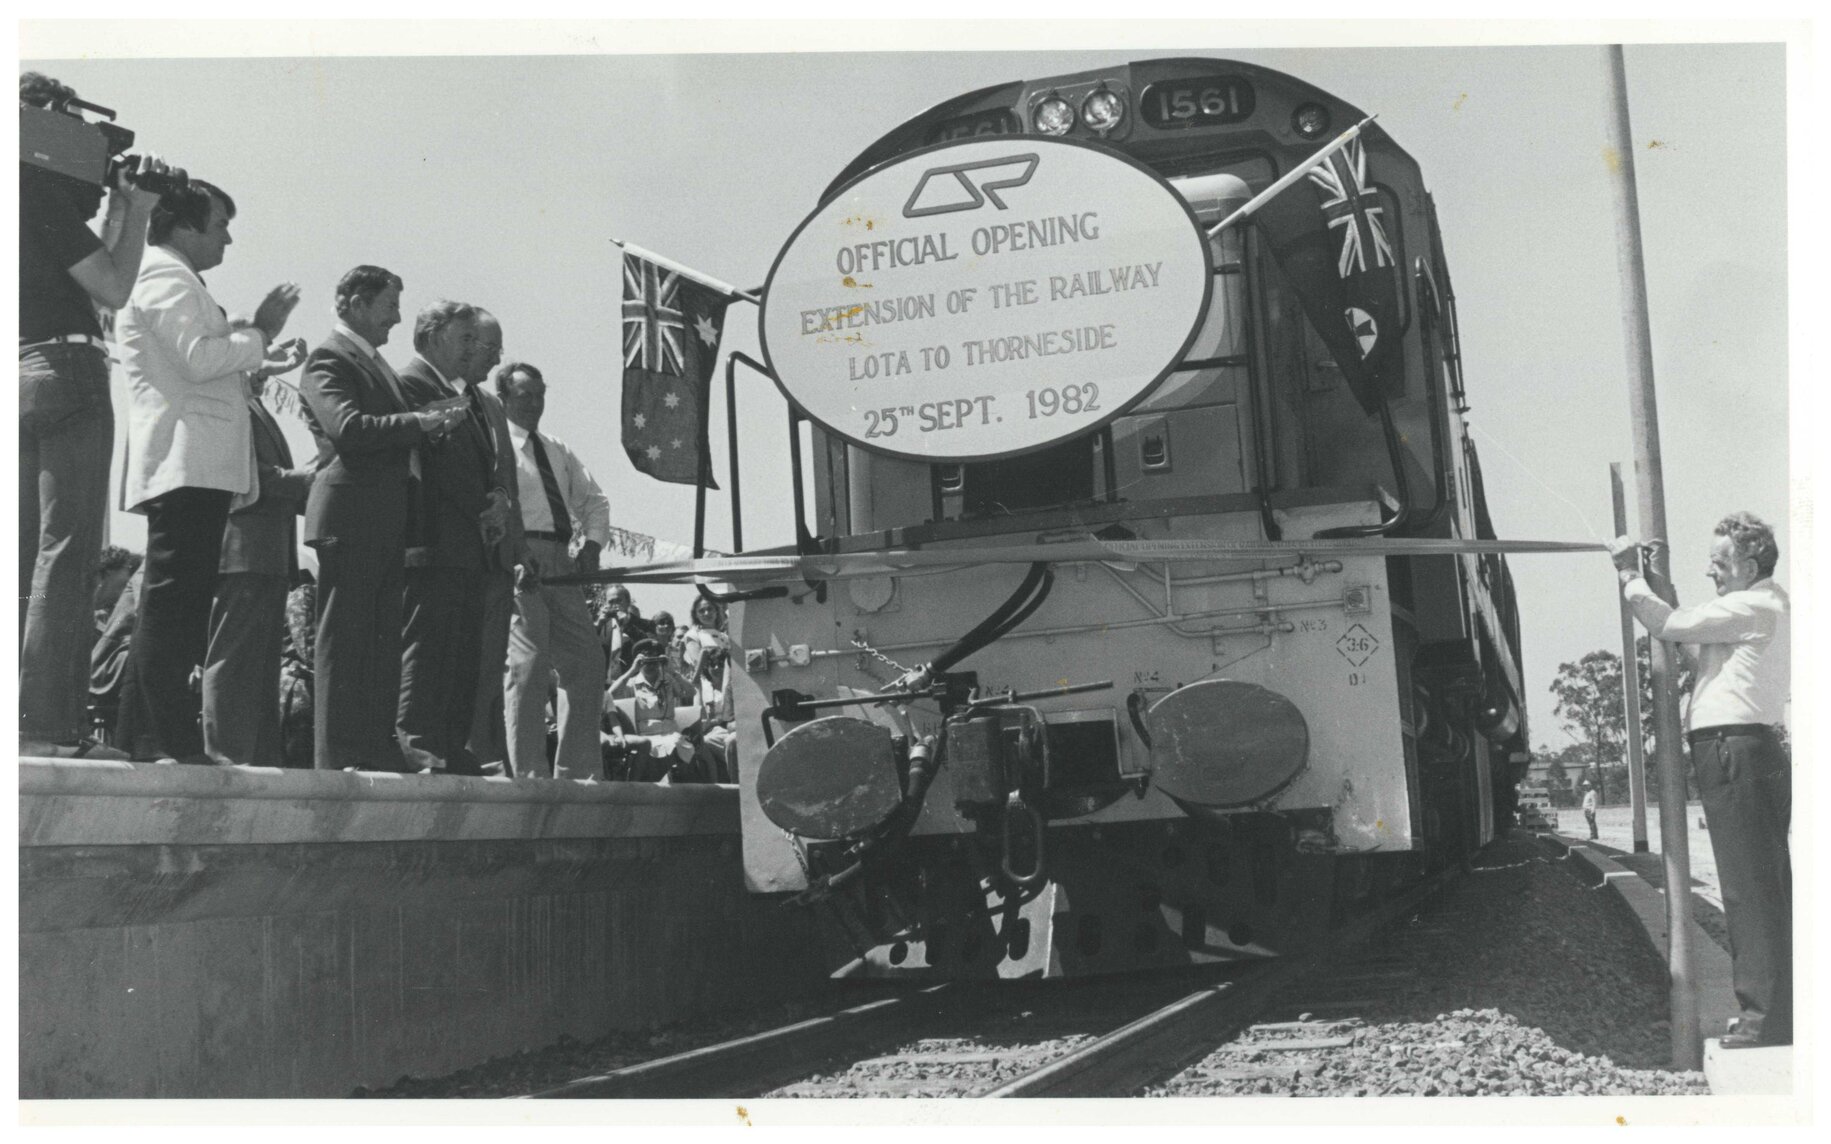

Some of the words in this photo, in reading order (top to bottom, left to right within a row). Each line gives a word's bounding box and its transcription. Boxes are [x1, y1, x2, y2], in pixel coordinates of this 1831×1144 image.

[1160, 87, 1240, 121] 1561
[836, 232, 958, 276] OFFICIAL
[971, 211, 1100, 257] OPENING
[800, 294, 936, 336] EXTENSION
[946, 288, 978, 315] OF
[987, 279, 1040, 310] THE
[1049, 261, 1164, 302] RAILWAY
[848, 351, 912, 381] LOTA
[919, 345, 951, 372] TO
[962, 323, 1118, 366] THORNESIDE
[863, 405, 915, 439] 25TH
[919, 395, 1003, 433] SEPT.
[1025, 382, 1101, 421] 1982
